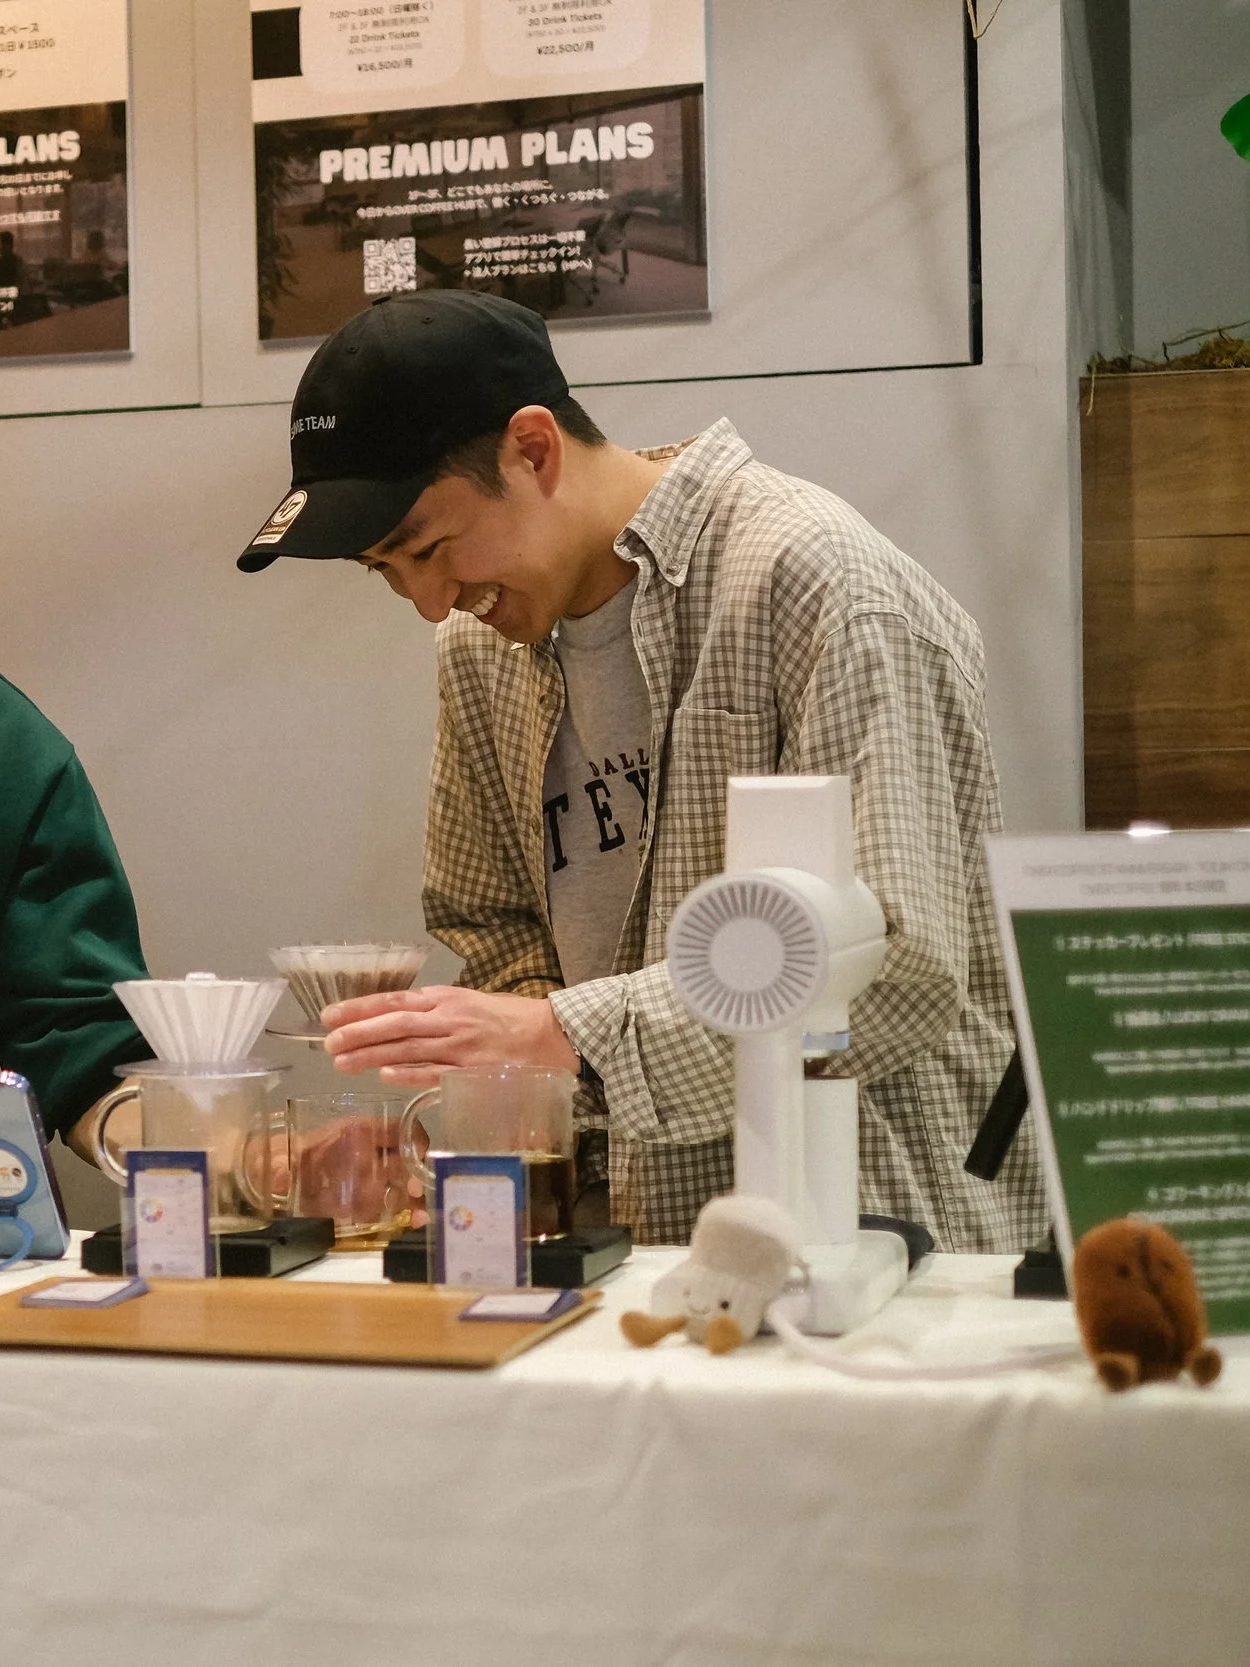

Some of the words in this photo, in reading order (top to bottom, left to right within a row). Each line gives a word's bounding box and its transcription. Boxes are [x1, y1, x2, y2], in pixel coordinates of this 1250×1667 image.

[319, 136, 509, 184] PREMIUM
[521, 122, 654, 167] PLANS
[304, 415, 336, 431] TEAM
